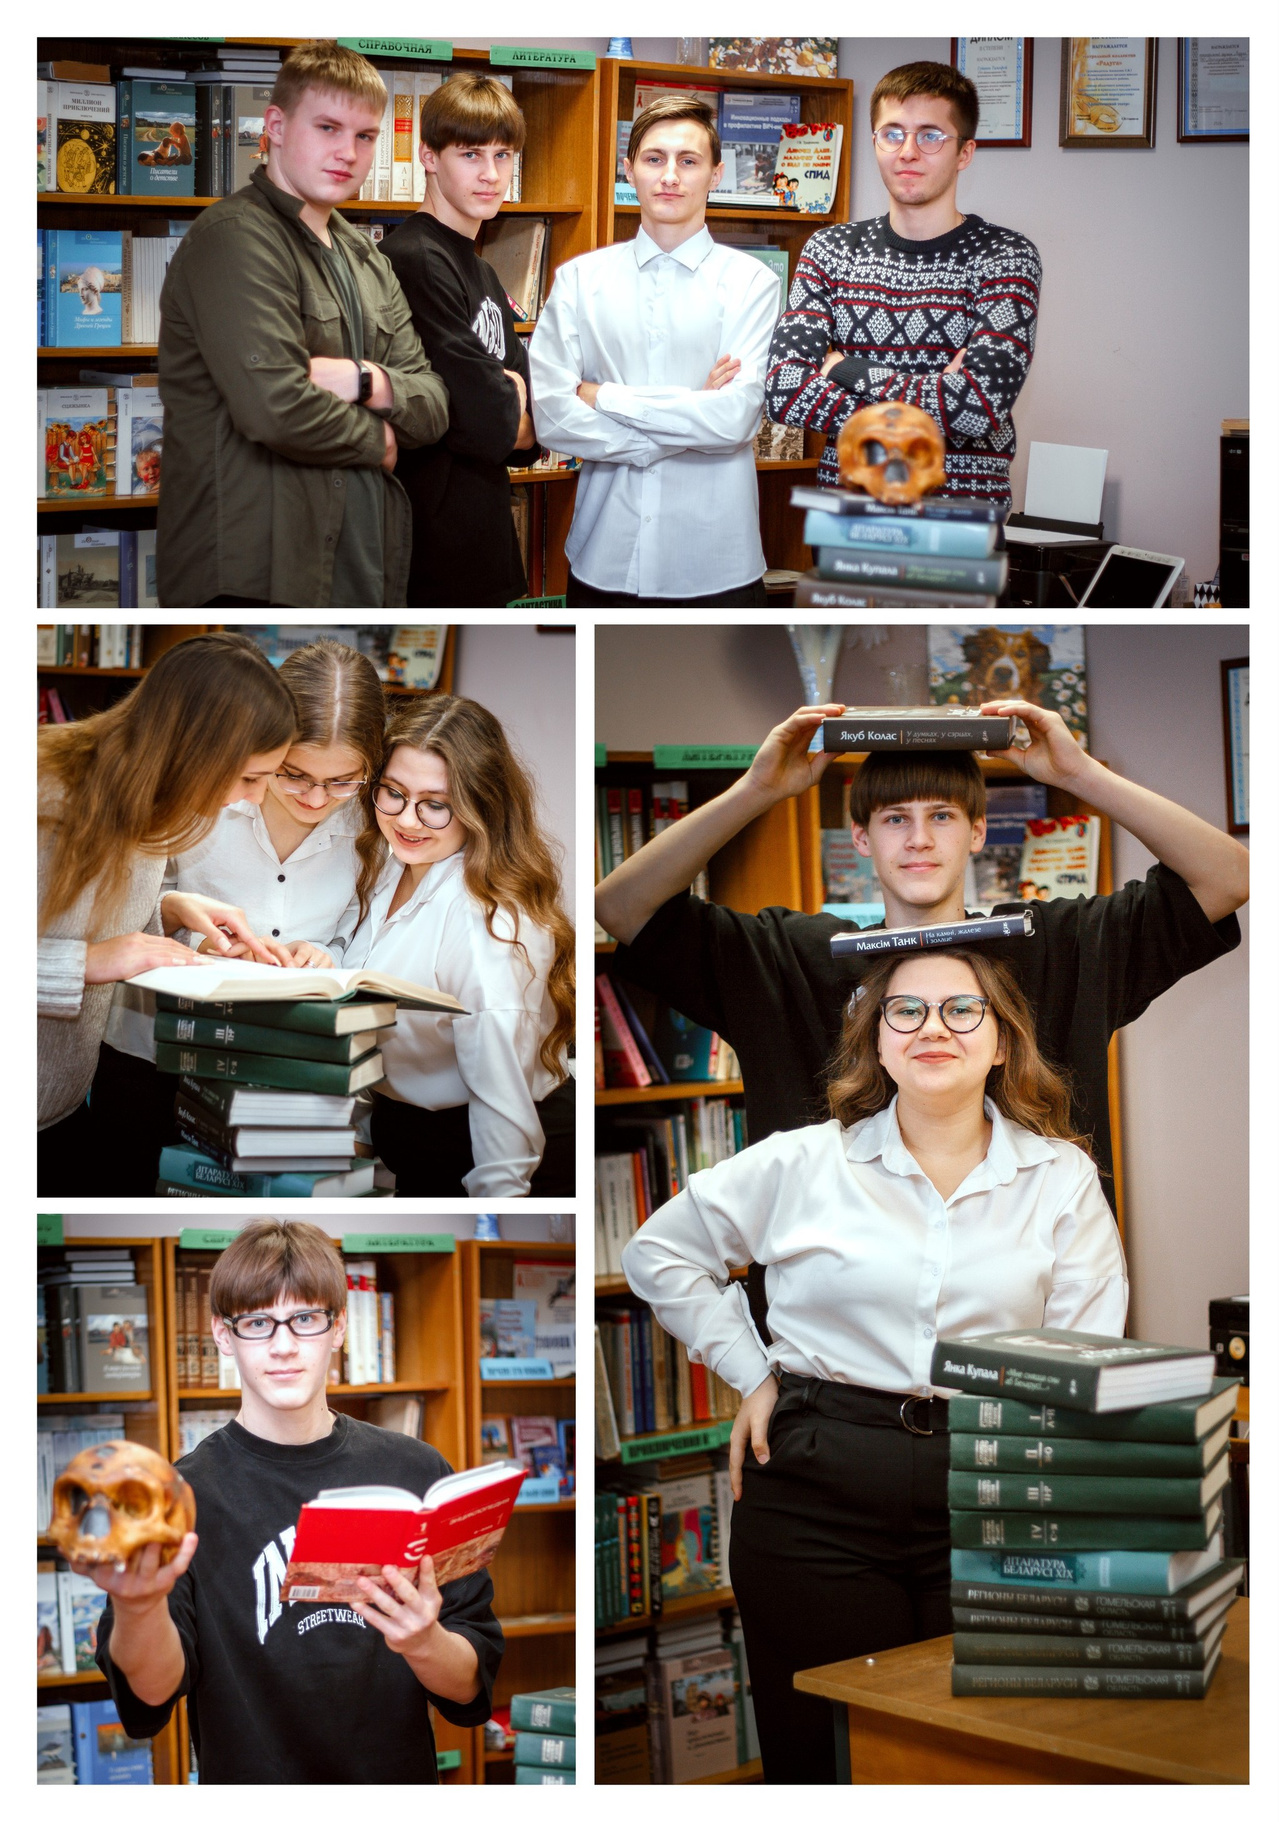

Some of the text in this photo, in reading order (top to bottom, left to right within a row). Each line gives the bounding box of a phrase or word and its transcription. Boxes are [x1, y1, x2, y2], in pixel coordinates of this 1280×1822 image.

[358, 39, 433, 54] СПРАВОЧНАЯ
[512, 51, 577, 64] ЛИТЕРАТУРА
[71, 98, 102, 106] МИЛЛИОН
[62, 104, 111, 114] ПРИКЛЮЧЕНИЙ
[150, 168, 178, 176] Писатели
[804, 170, 830, 180] СПИД
[616, 192, 638, 201] ПОЧЕМ
[840, 730, 864, 742] Якуб
[867, 730, 897, 741] Колас
[856, 936, 918, 952] Максім Танк
[943, 1360, 966, 1375] Янка
[966, 1363, 998, 1380] Купала
[1004, 1564, 1074, 1580] БЕЛАРУСІ XIX
[968, 1589, 1014, 1601] РЕГИОНЫ
[1096, 1596, 1156, 1610] ГОМЕЛЬСКАЯ
[297, 1608, 366, 1636] STREETWEAR
[1108, 1644, 1171, 1654] ГОМЕЛЬСКАЯ
[1106, 1674, 1170, 1685] ГОМЕЛЬСКАЯ
